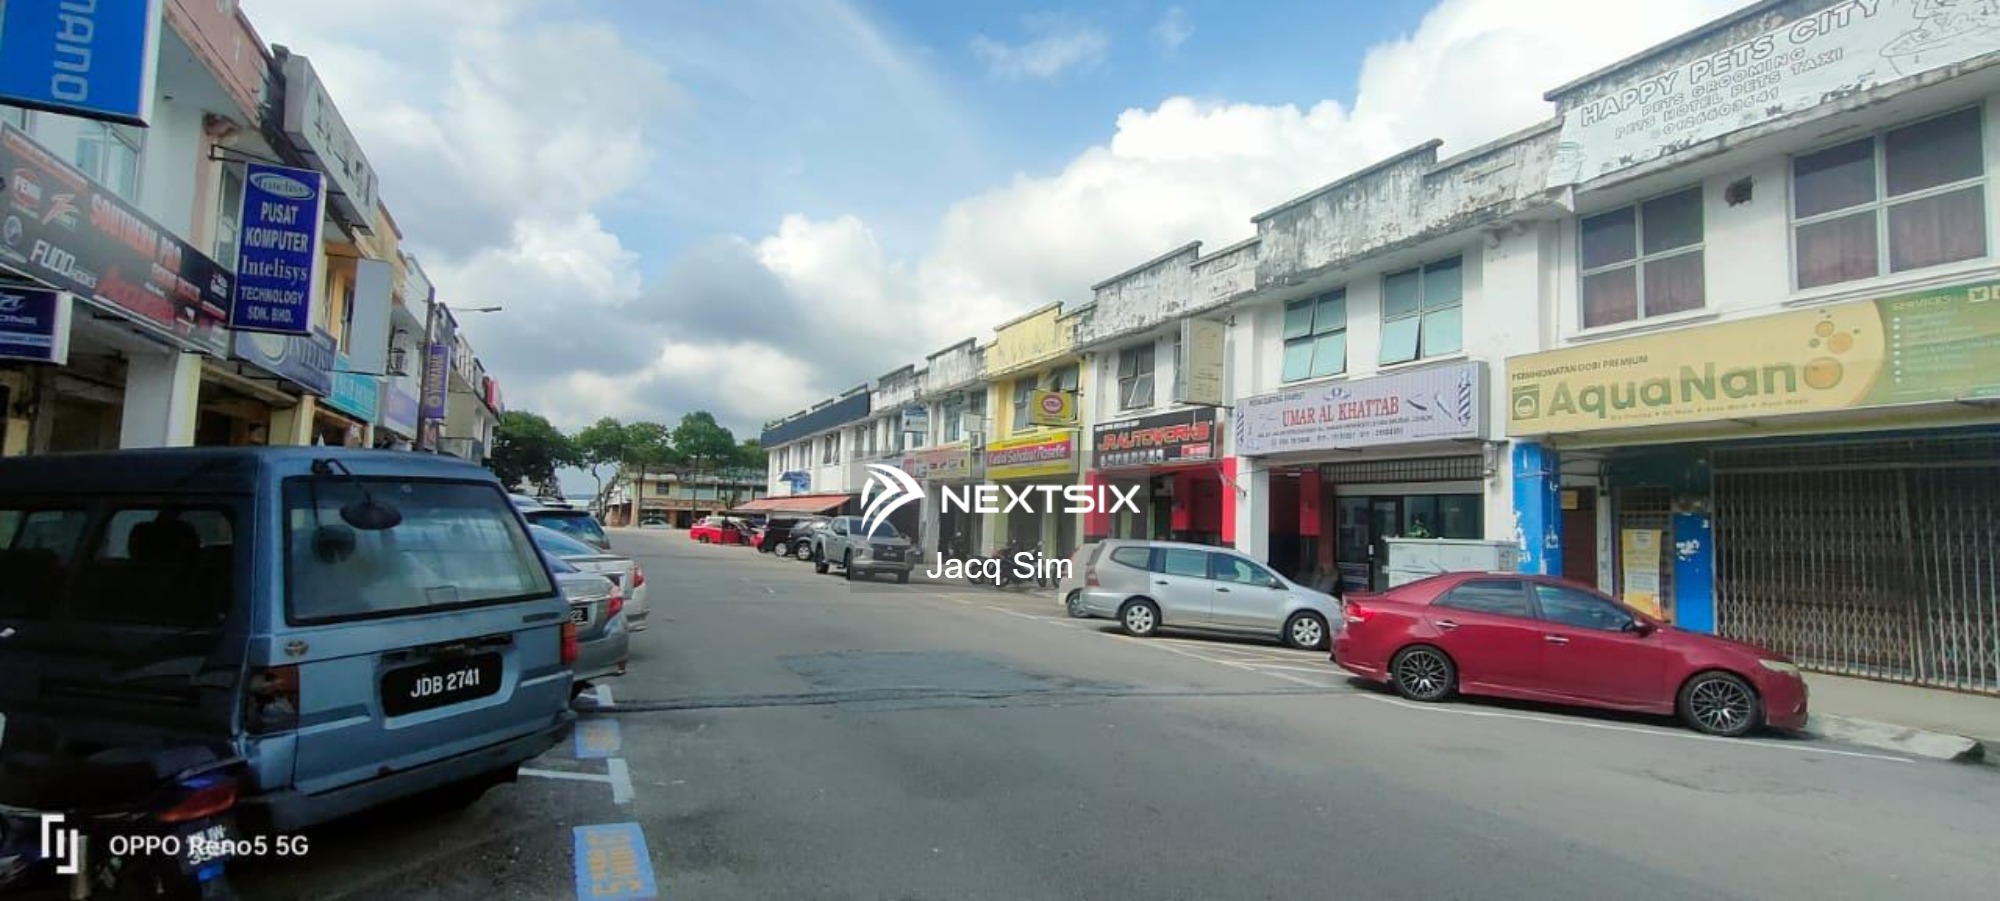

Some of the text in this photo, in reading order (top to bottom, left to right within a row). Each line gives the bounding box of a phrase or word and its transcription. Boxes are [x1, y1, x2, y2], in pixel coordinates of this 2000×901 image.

[1580, 0, 1880, 127] HAPPY PETS CITY
[1641, 93, 1684, 117] PETS
[1692, 48, 1806, 98] GROOMING
[1664, 91, 1723, 122] HOTEL
[1731, 69, 1781, 98] PETS
[1792, 48, 1843, 76] TAXI
[260, 202, 299, 226] PUSAT
[245, 227, 309, 252] KOMPUTER
[241, 254, 308, 287] Intelisys
[240, 286, 304, 305] TECHNOLOGY
[1891, 294, 1952, 310] SERVICES
[1603, 355, 1649, 368] PREMIUM
[1282, 407, 1316, 427] UMAR
[1319, 404, 1335, 423] AL
[1338, 396, 1399, 421] KHATTAB
[410, 668, 480, 698] JDB 2741
